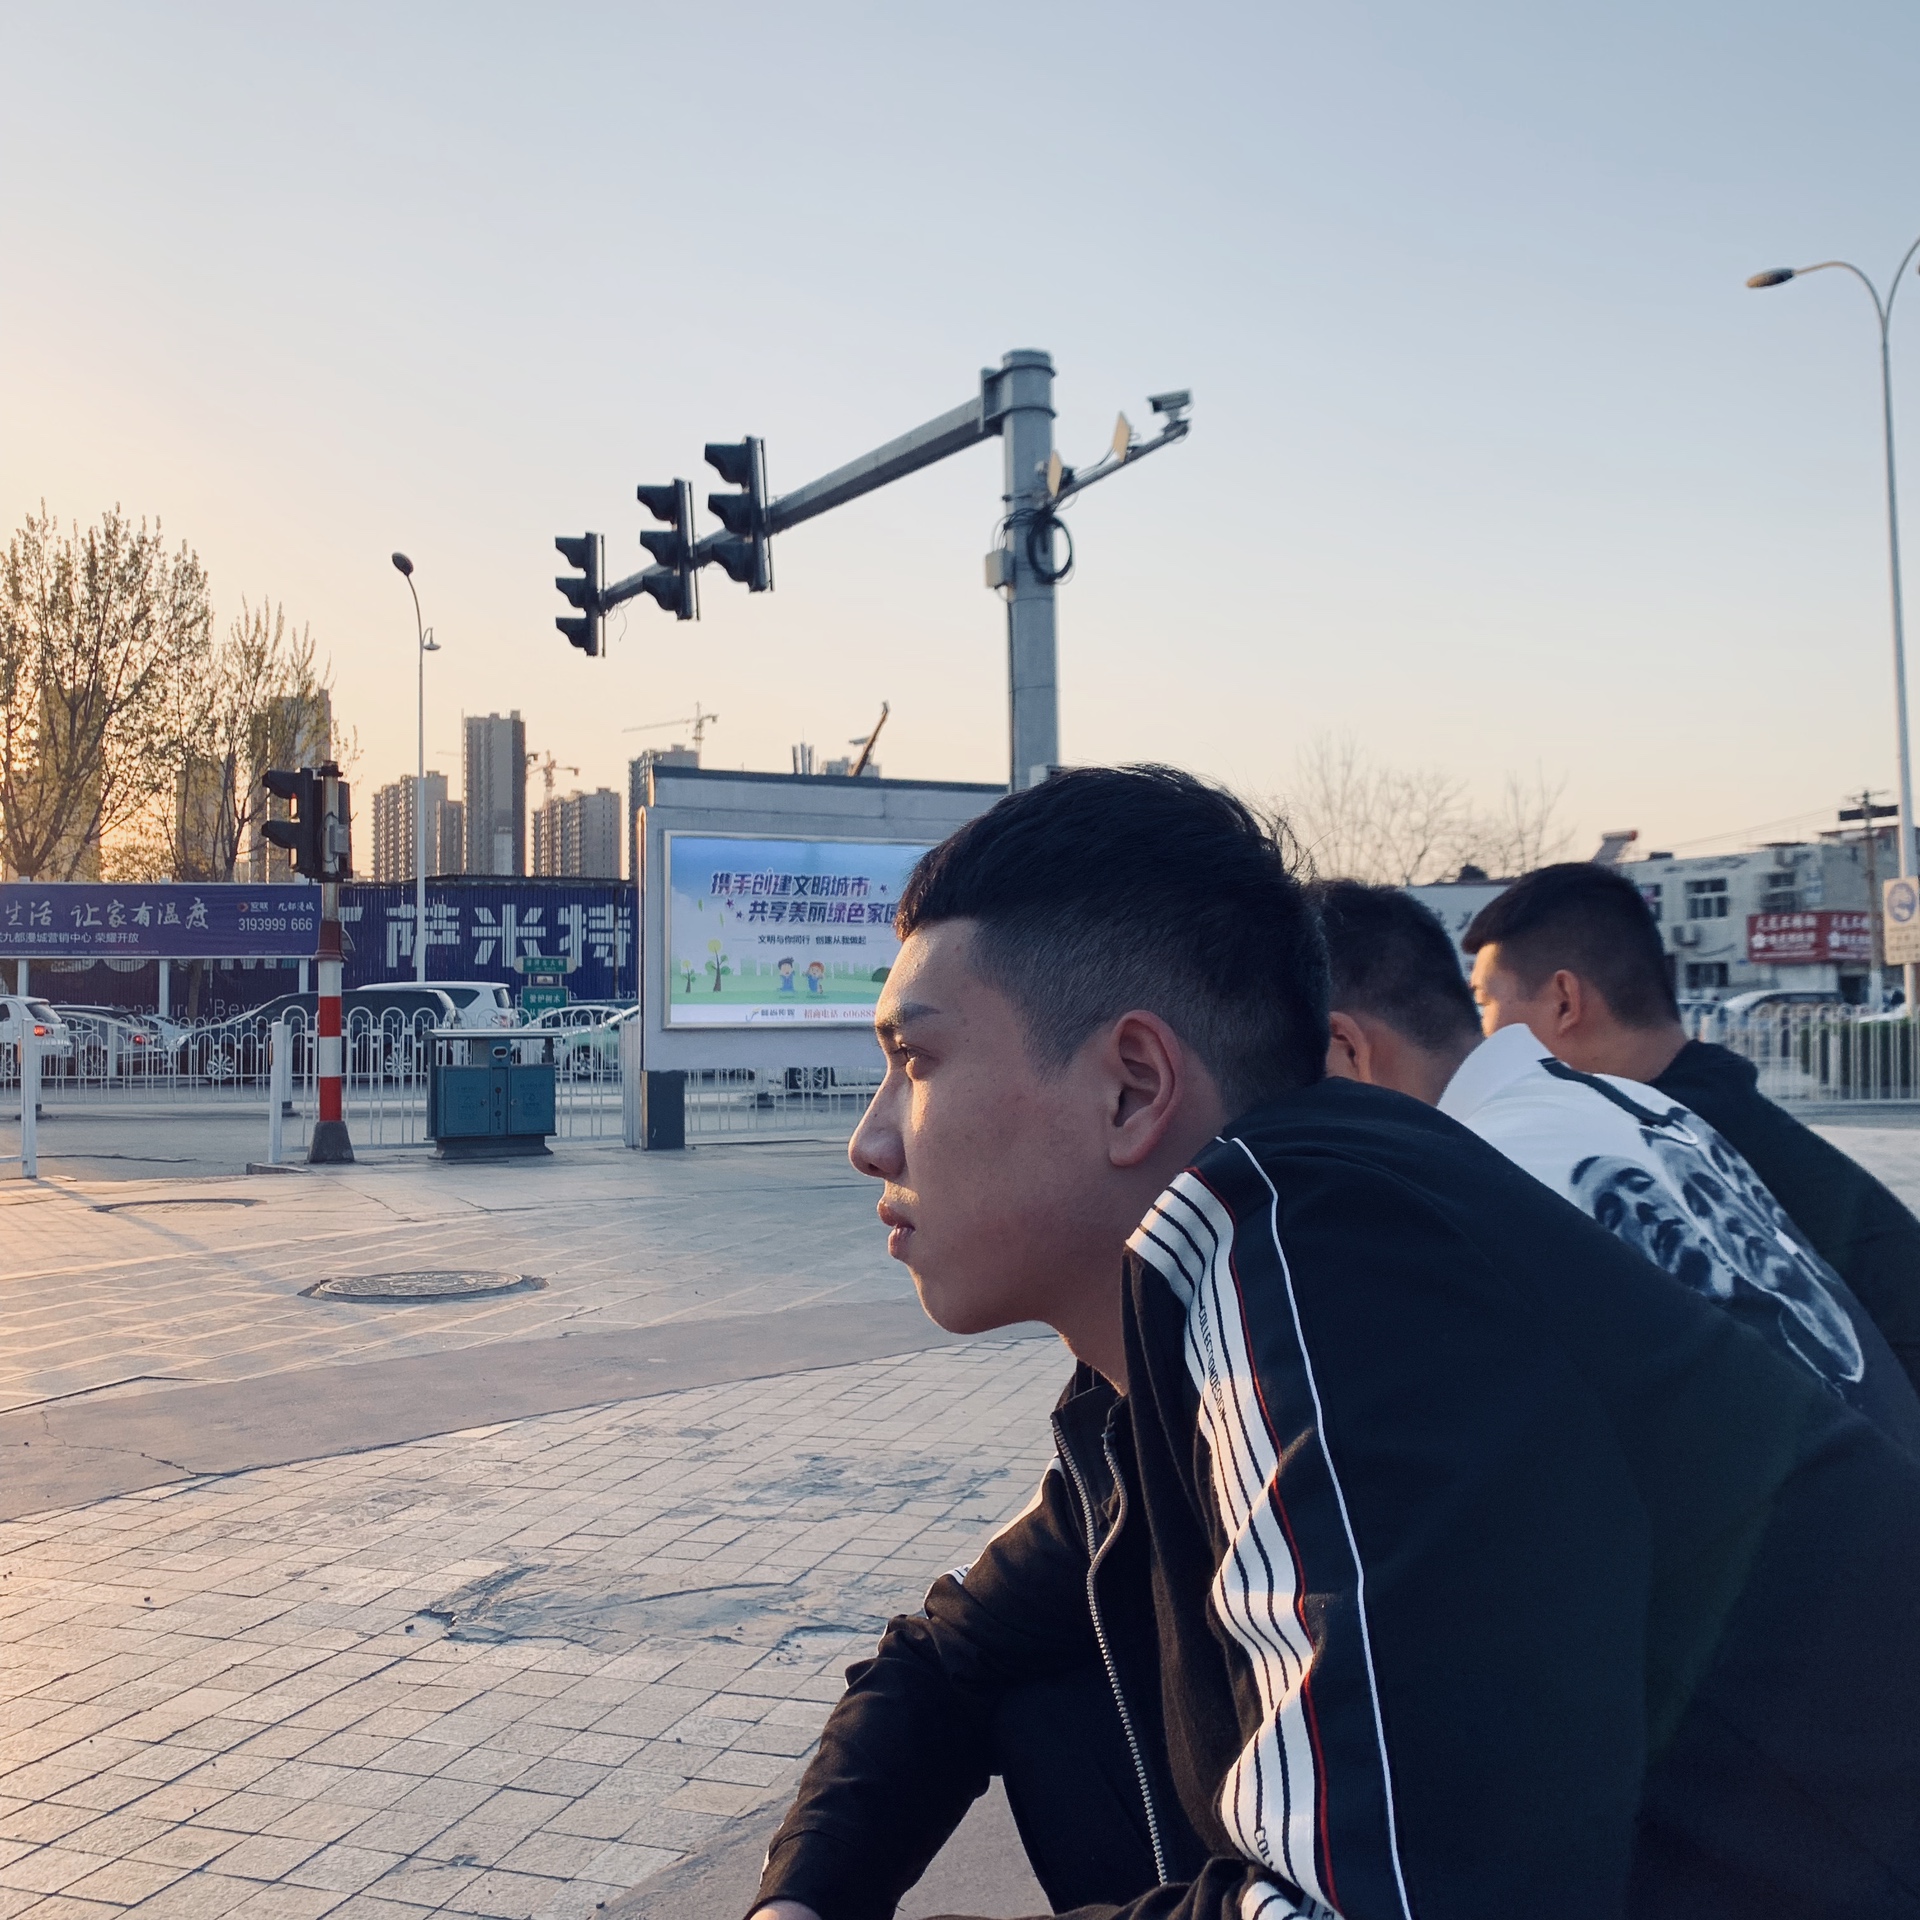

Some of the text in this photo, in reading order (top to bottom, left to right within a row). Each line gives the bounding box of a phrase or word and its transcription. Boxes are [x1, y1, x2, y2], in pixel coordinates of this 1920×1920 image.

[711, 872, 871, 897] 携手创建文明城市
[5, 897, 208, 930] 生活 让家有温度
[238, 917, 313, 931] 3193999 666
